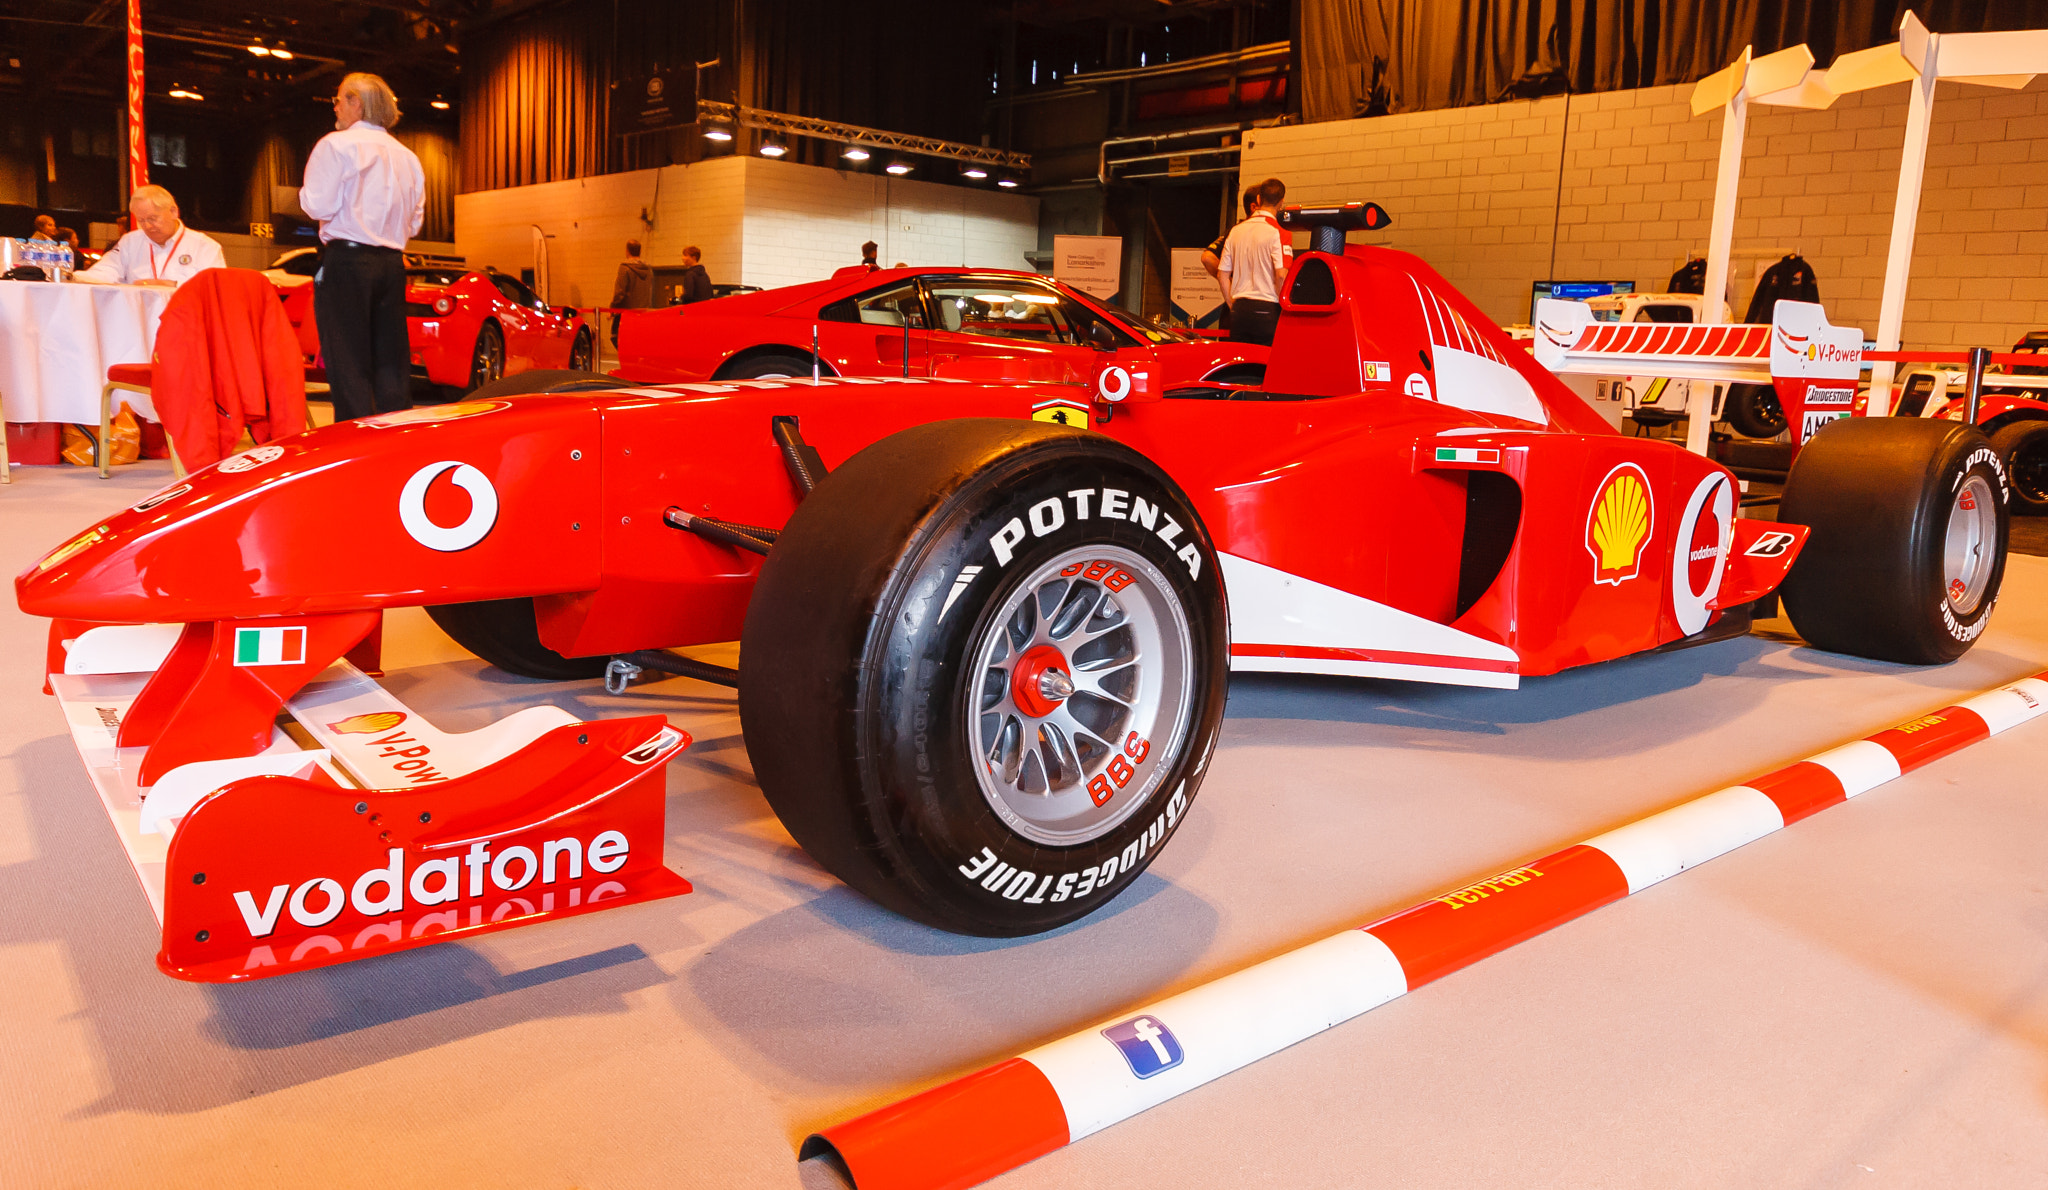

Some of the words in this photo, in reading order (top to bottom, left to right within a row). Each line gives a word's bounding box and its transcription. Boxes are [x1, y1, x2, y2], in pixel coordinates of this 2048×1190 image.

[1818, 343, 1861, 362] V-Power
[1807, 386, 1853, 402] BRIDGESTONE
[1802, 415, 1836, 442] AM
[1965, 448, 2010, 505] POTENZA
[989, 488, 1204, 582] POTENZA
[1690, 544, 1719, 562] vodafone
[1086, 730, 1151, 808] BBS
[958, 778, 1187, 904] BRIDGESTONE
[233, 831, 630, 938] vodafone
